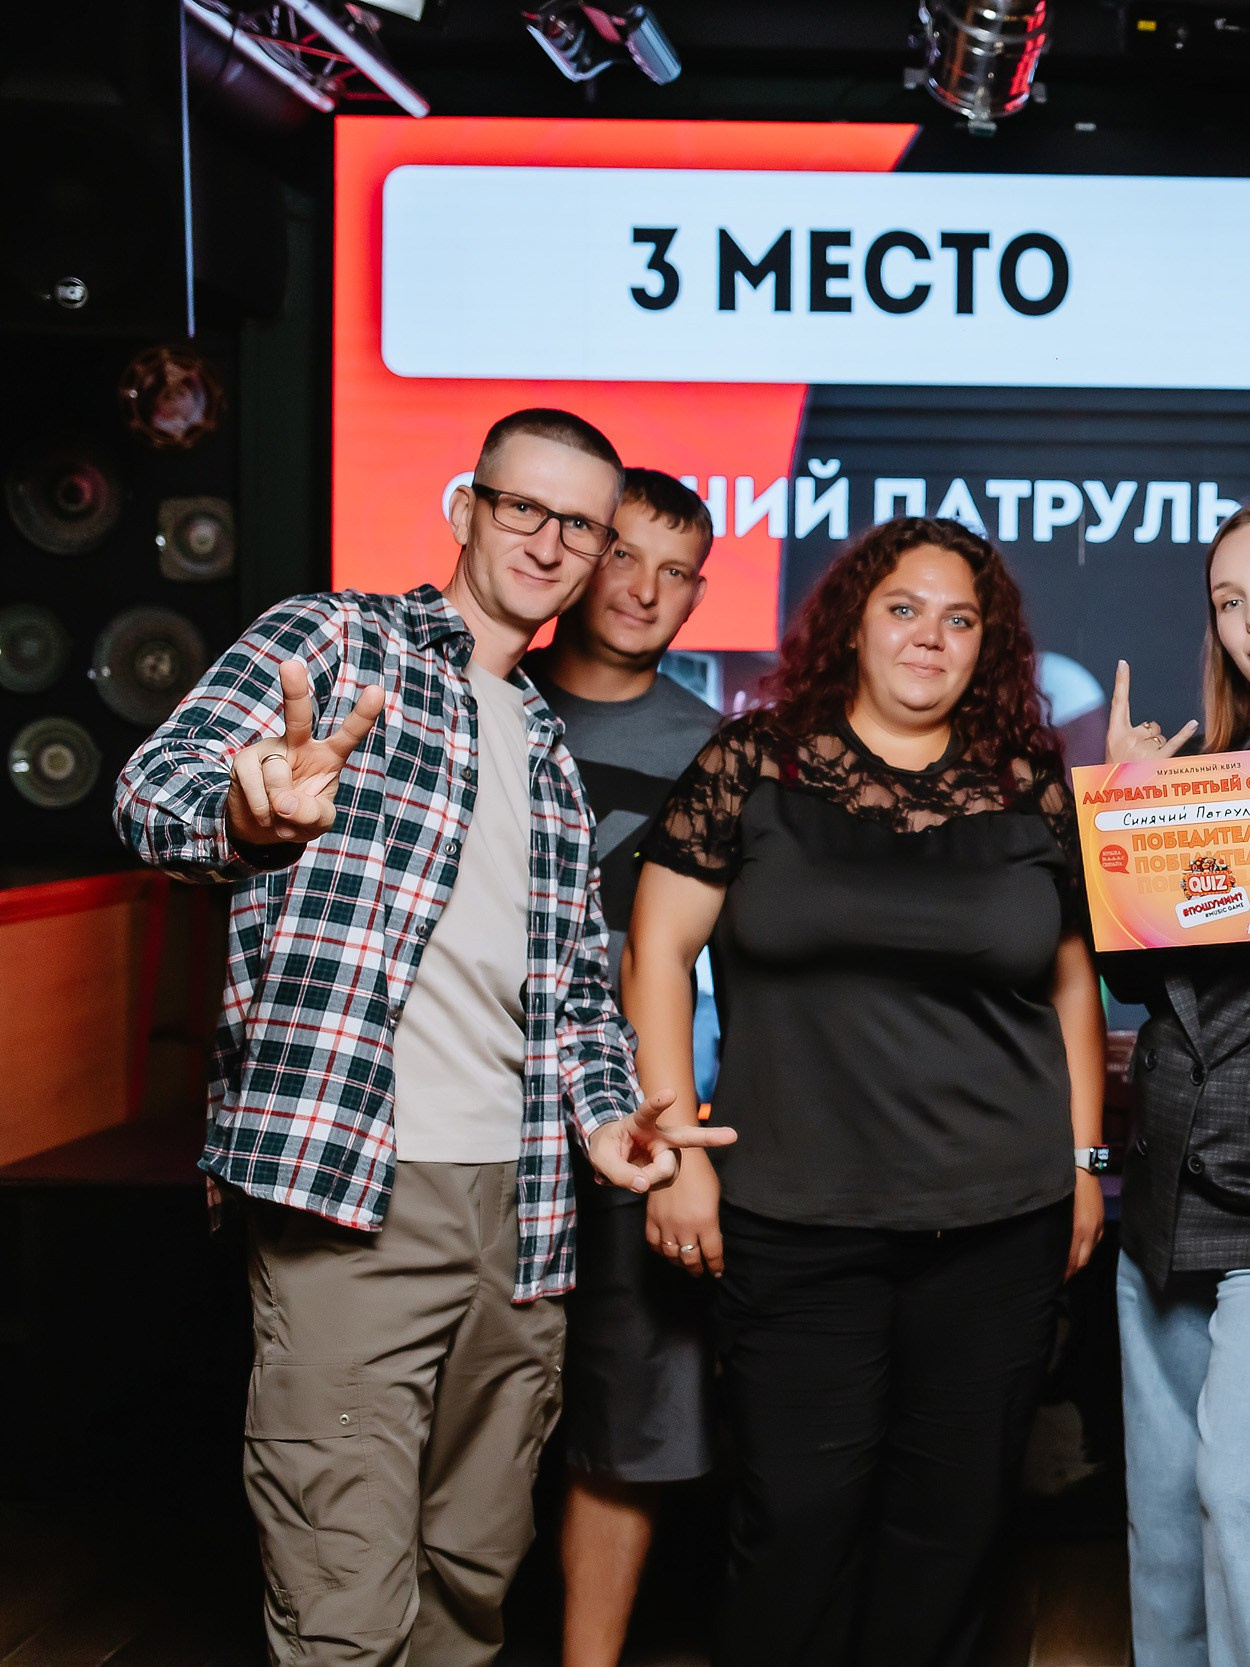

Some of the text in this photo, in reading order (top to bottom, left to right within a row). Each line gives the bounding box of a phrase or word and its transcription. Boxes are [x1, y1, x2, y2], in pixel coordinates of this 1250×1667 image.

[630, 226, 1069, 316] 3 МЕСТО
[873, 477, 1242, 544] ПАТРУЛЬ
[1157, 763, 1218, 776] МУЗЫКАЛЬНЫЙ
[1082, 784, 1168, 805] ЛАУРЕАТЫ
[1171, 774, 1242, 797] ТРЕТЬЕЙ
[1188, 874, 1228, 893] QUIZ
[1227, 902, 1244, 912] GAME
